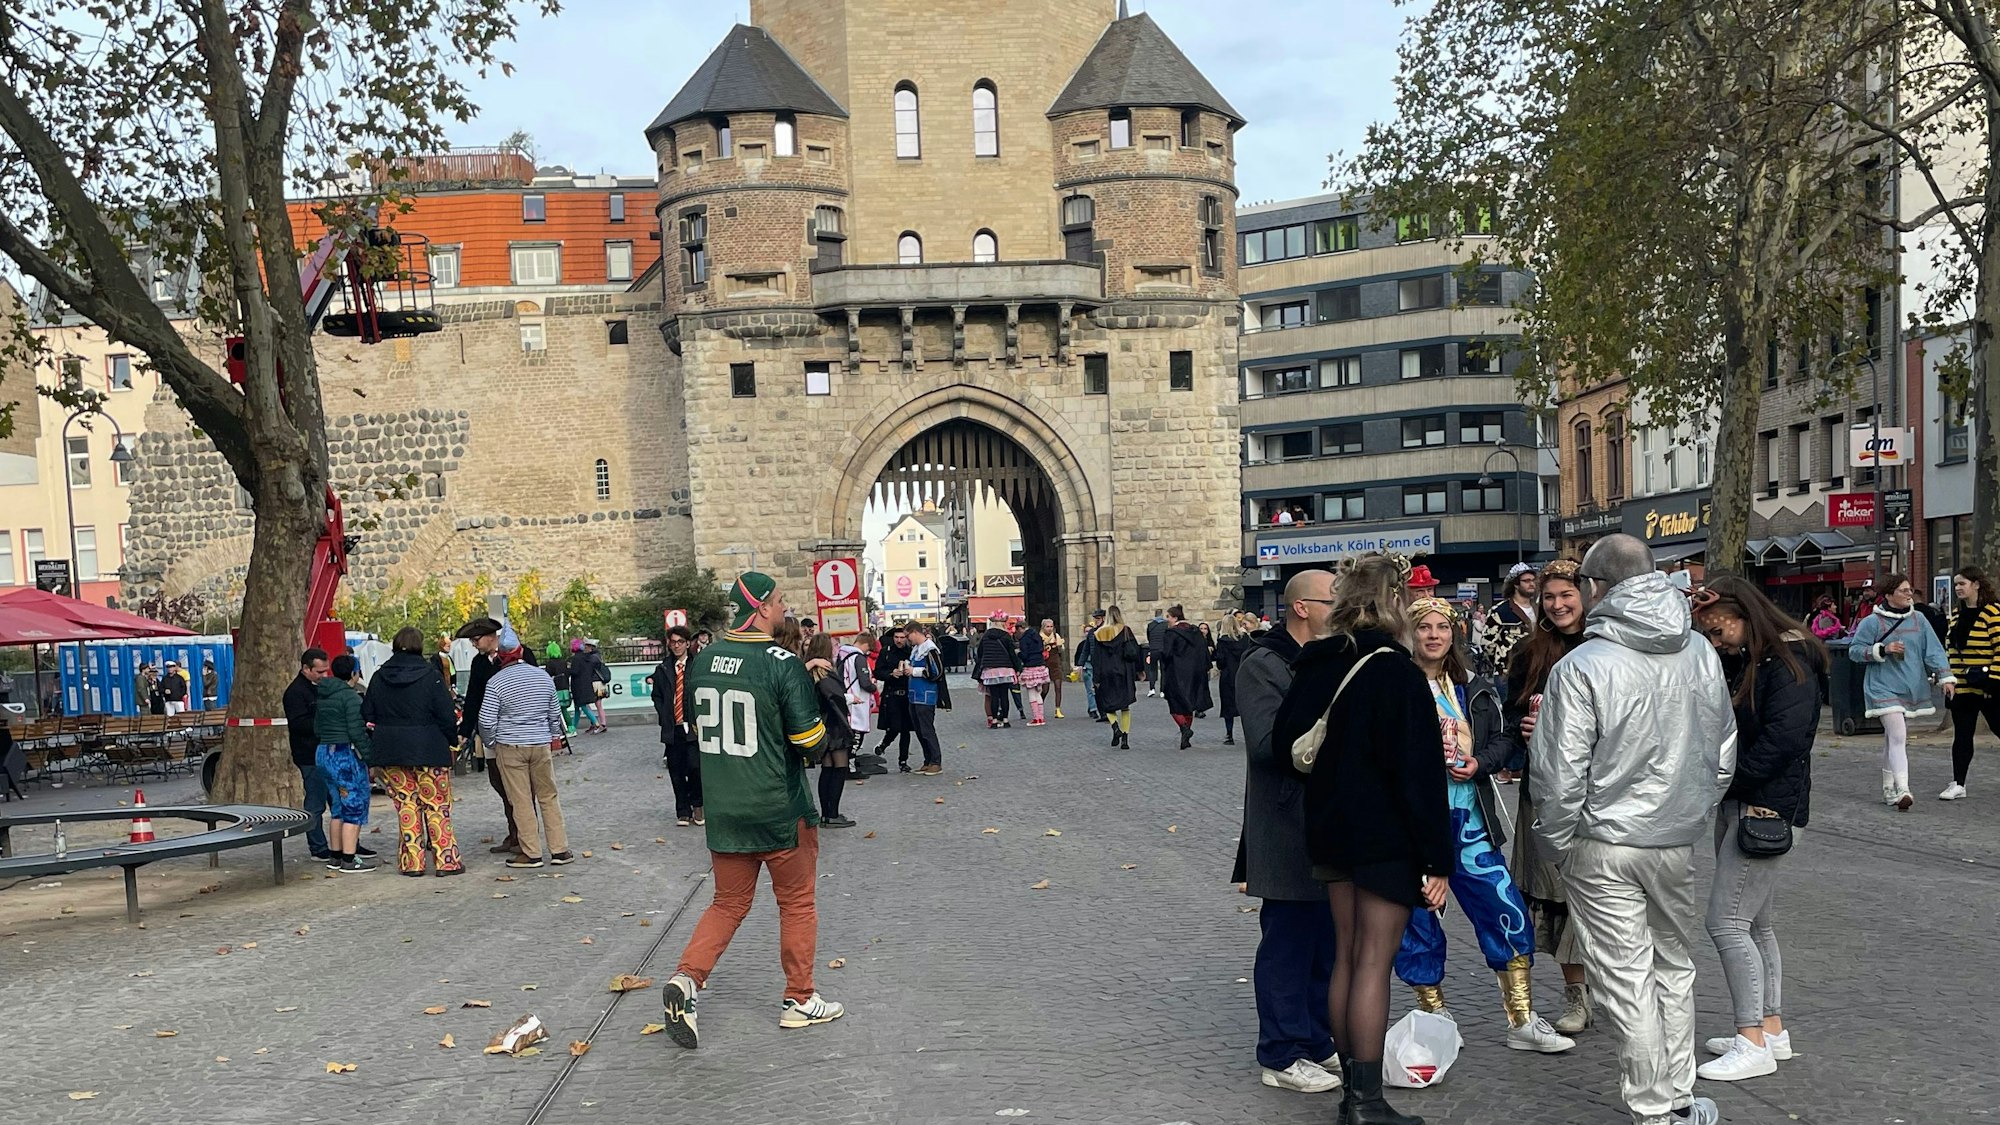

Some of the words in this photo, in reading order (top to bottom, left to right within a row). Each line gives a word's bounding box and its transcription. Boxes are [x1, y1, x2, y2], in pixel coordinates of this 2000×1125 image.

[1838, 506, 1874, 518] rieker
[1660, 511, 1698, 537] Tchibo
[1282, 541, 1344, 556] Volksbank
[1348, 539, 1375, 551] Köln
[1415, 535, 1431, 547] eG
[986, 575, 1015, 587] CAN
[818, 598, 858, 607] Information
[710, 655, 743, 675] BIGBY
[694, 687, 758, 758] 20
